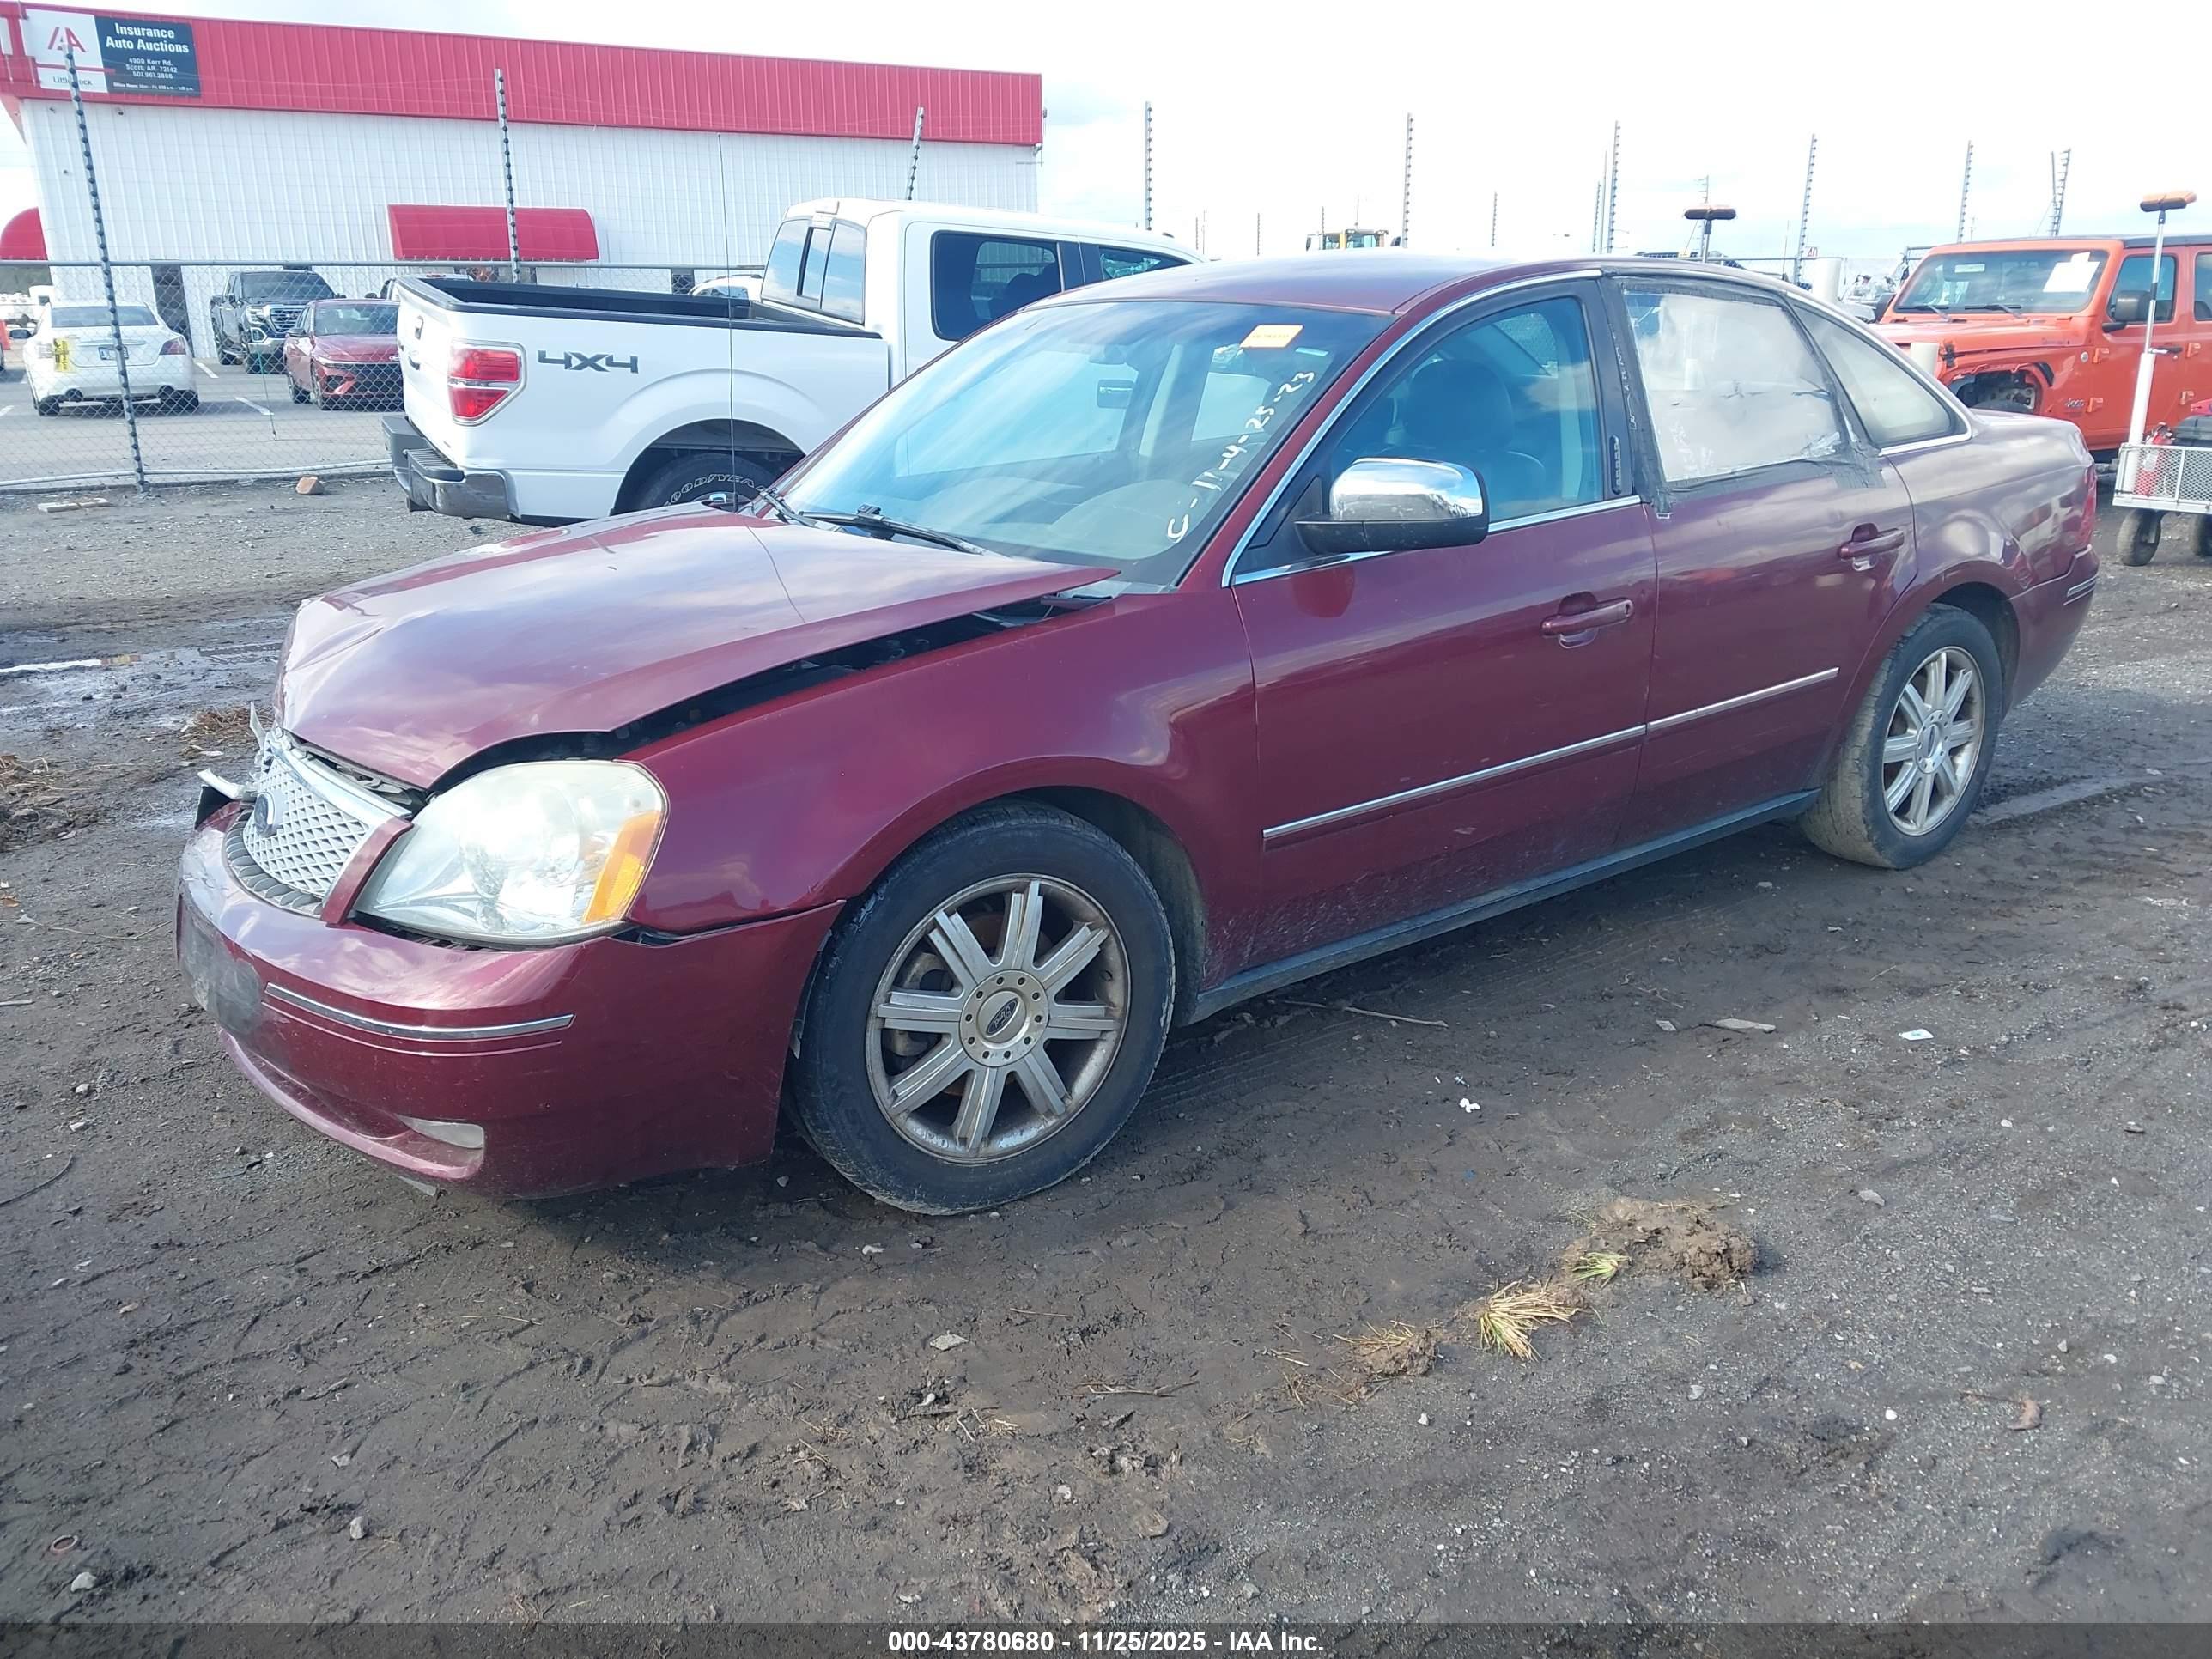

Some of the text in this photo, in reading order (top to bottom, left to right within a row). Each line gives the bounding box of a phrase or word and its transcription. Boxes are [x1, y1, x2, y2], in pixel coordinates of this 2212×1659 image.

[114, 22, 175, 39] Insurance
[106, 35, 190, 53] Auto Auctions
